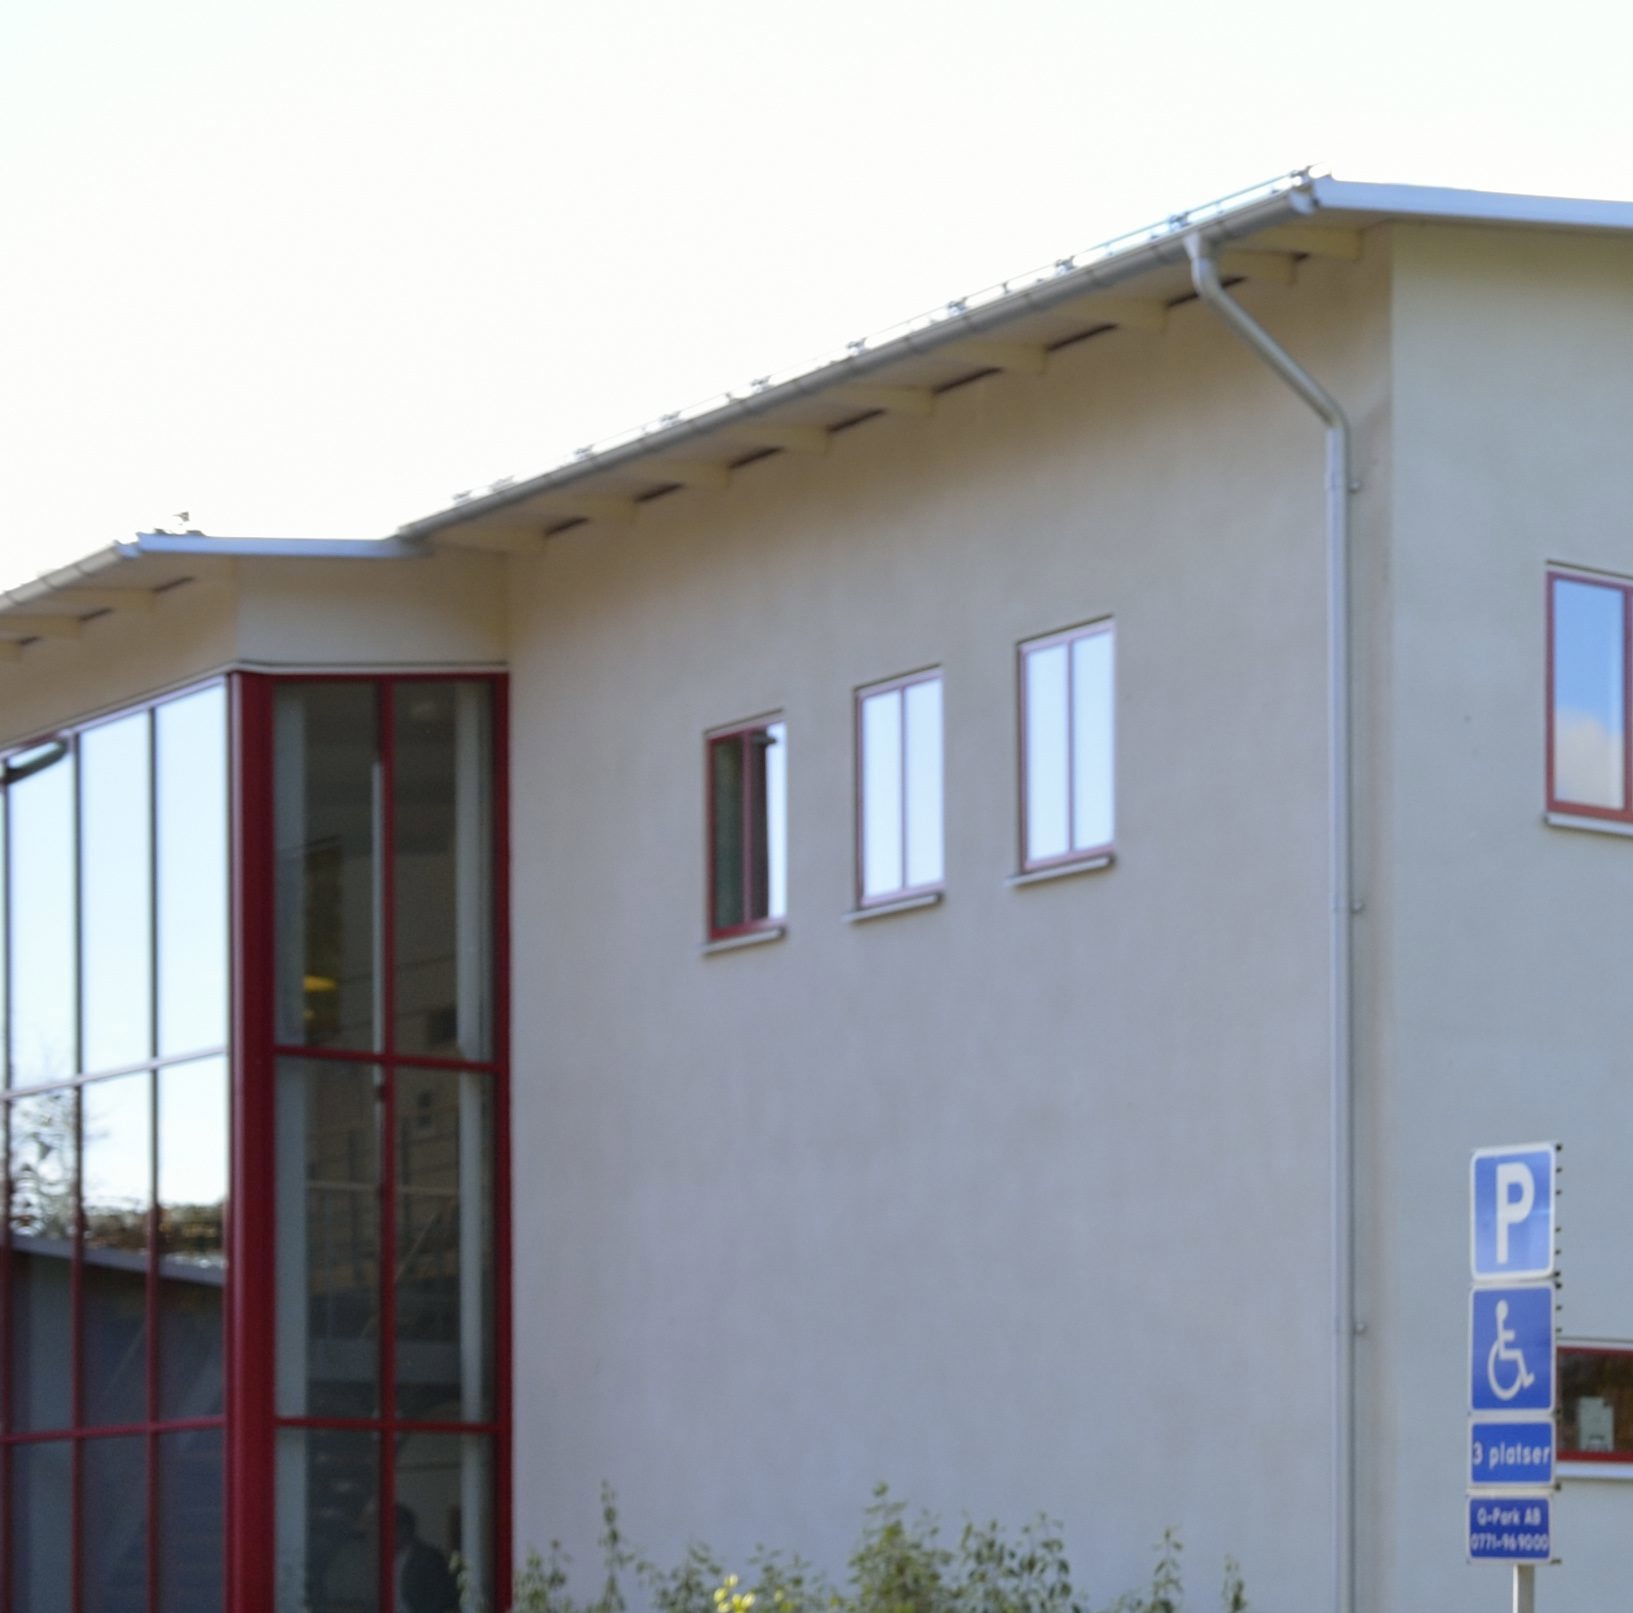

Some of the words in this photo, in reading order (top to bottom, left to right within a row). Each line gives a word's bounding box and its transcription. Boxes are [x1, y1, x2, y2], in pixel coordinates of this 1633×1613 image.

[1495, 1161, 1535, 1265] P
[1472, 1441, 1483, 1465] 3
[1489, 1441, 1551, 1469] platser
[1524, 1506, 1541, 1526] AB
